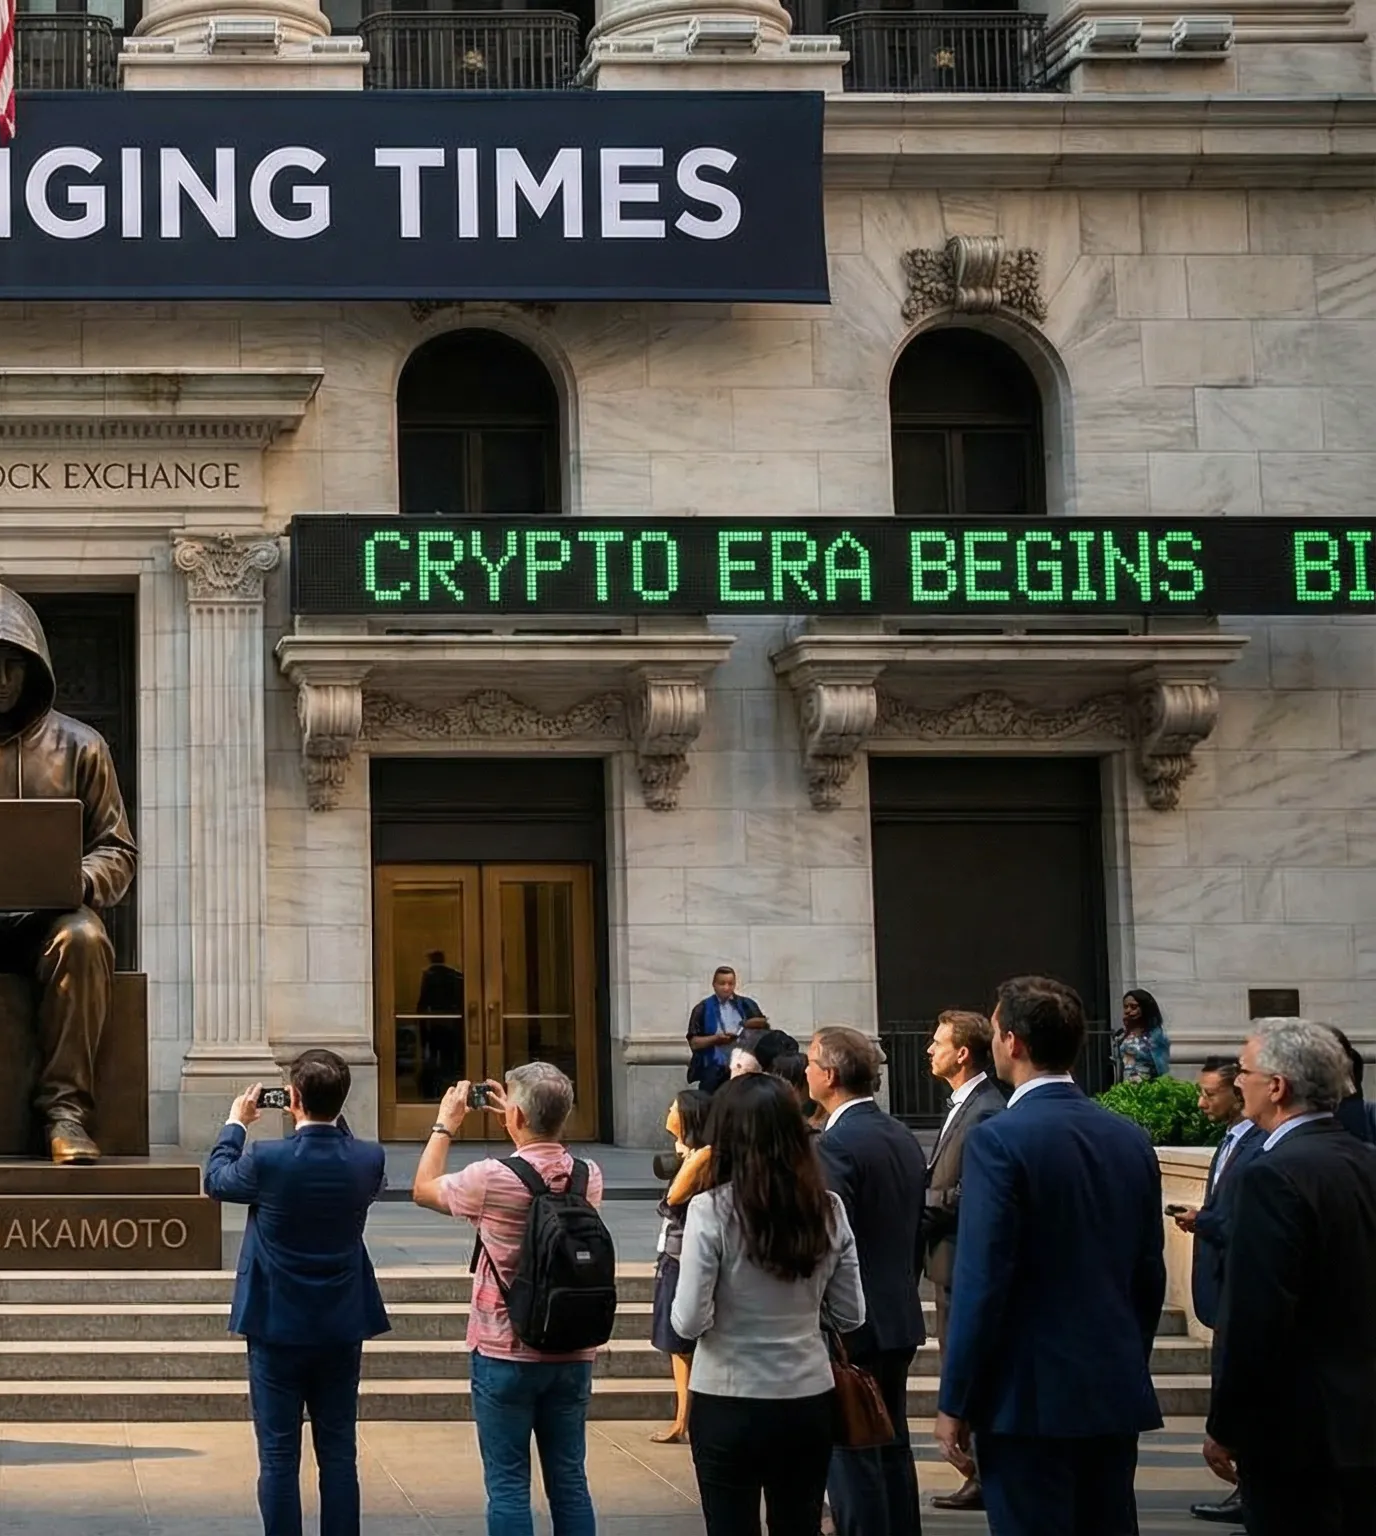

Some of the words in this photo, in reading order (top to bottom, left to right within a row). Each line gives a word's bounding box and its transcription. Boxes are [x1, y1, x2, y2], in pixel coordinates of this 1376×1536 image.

[374, 147, 741, 240] TIMES
[63, 462, 240, 490] EXCHANGE
[364, 530, 679, 601] CRYPTO
[718, 530, 872, 601] ERA
[910, 531, 1204, 602] BEGINS
